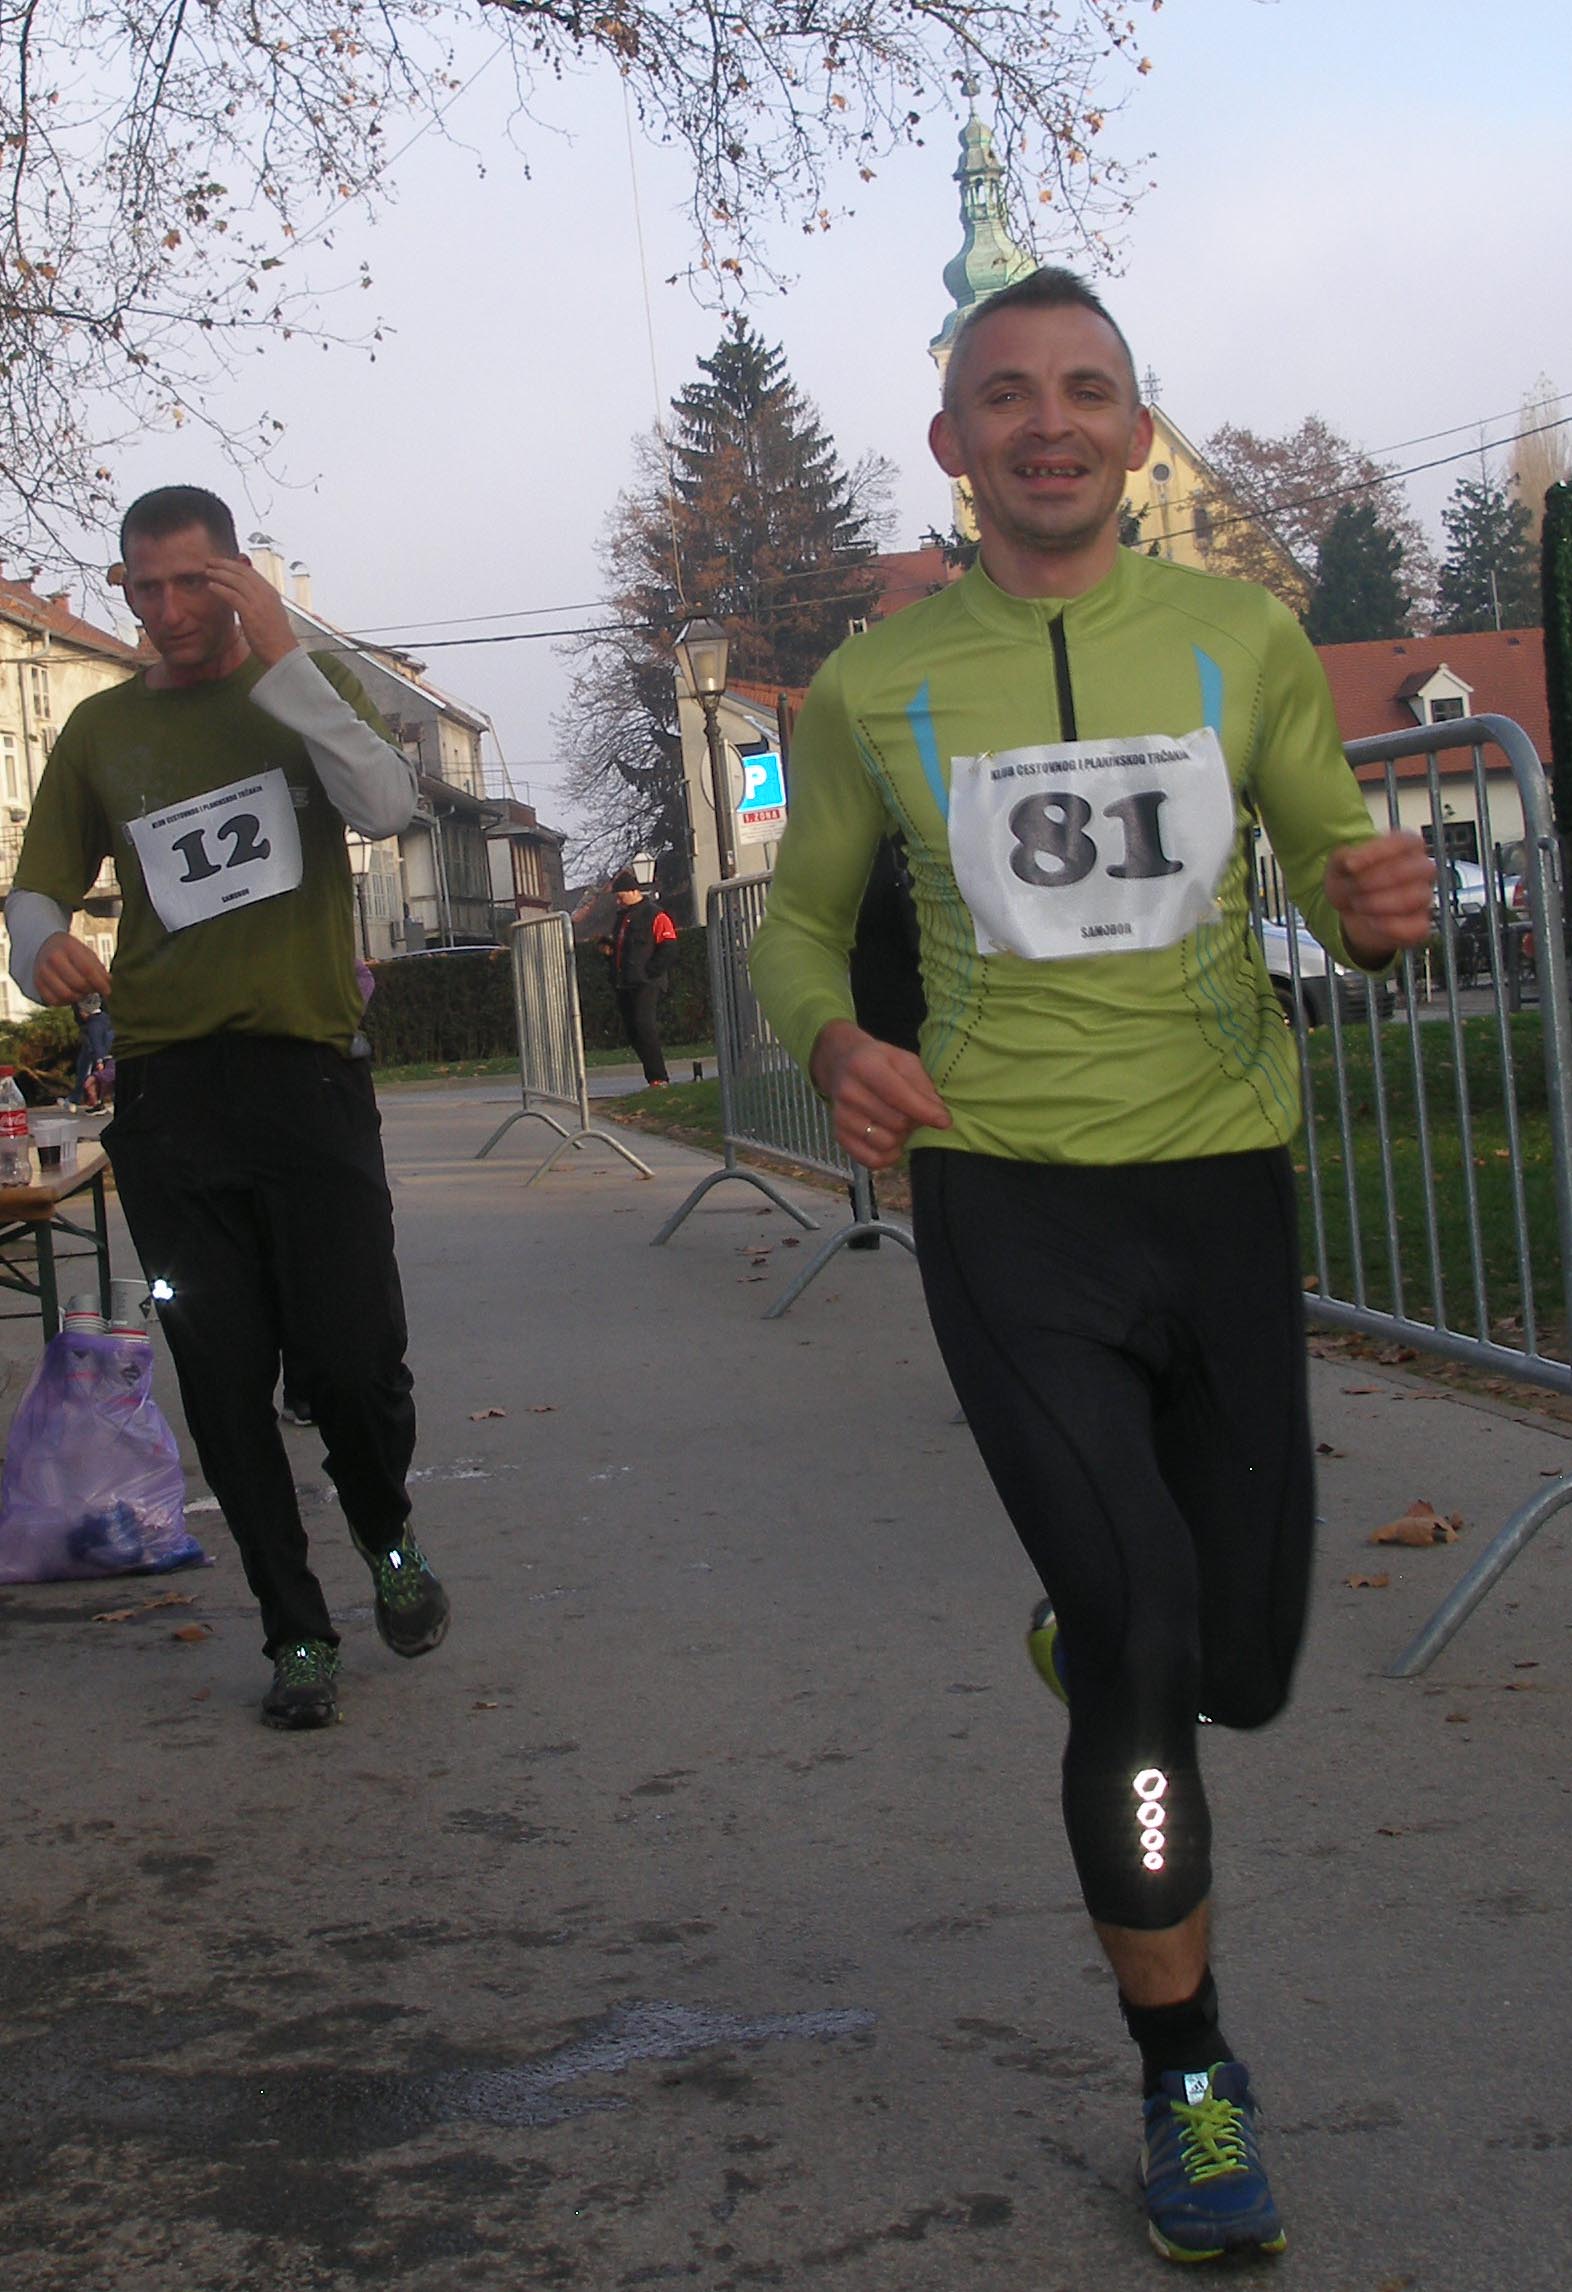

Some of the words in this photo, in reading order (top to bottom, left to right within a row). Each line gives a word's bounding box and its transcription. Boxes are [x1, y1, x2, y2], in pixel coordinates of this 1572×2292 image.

[745, 765, 767, 799] P
[991, 766, 1014, 780] KLUB
[1017, 760, 1076, 776] CESTOVNOG
[1085, 753, 1146, 769] PLANINSKOG
[172, 814, 271, 882] 12
[1008, 791, 1183, 887] 81
[1081, 923, 1132, 938] SAMOBOR
